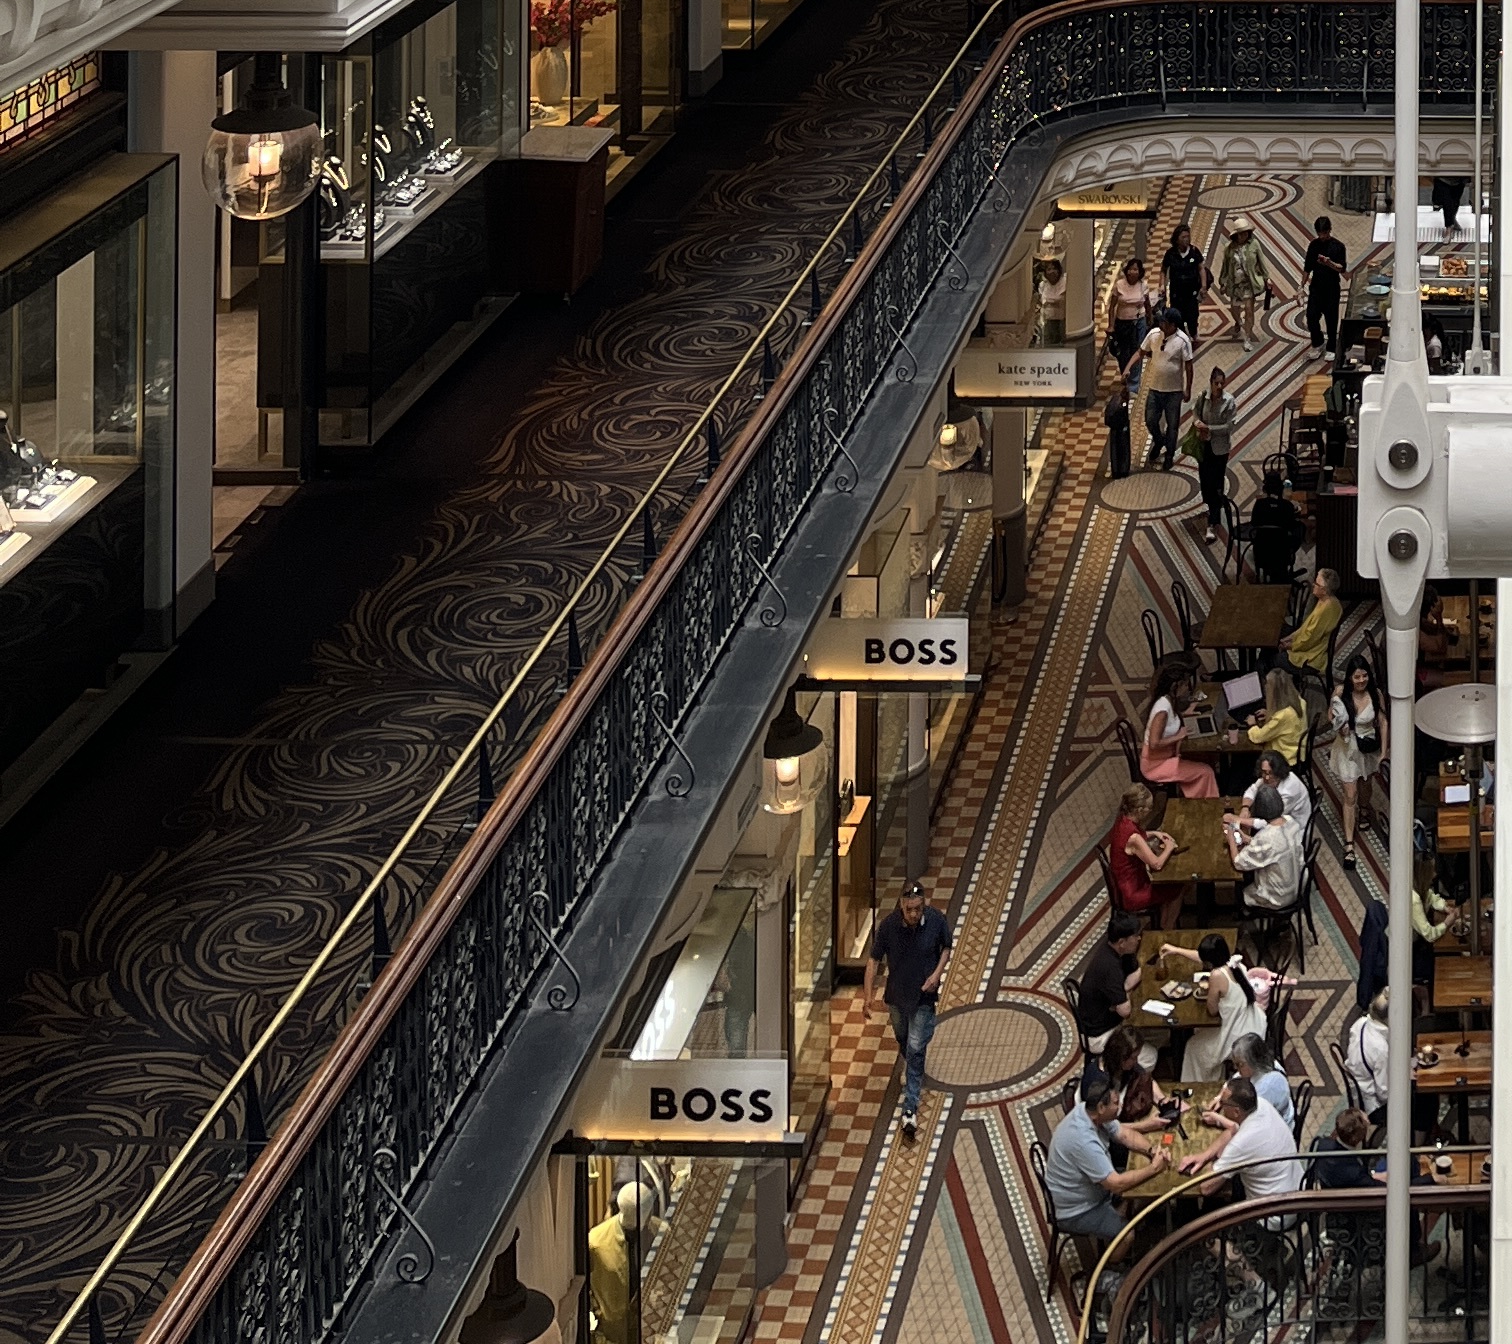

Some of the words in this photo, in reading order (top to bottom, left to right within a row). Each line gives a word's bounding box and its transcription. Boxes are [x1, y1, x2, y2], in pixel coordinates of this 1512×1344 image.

[1078, 194, 1141, 205] SWAROVSKI
[998, 363, 1026, 374] kate
[1030, 363, 1069, 378] spade
[865, 638, 957, 665] BOSS
[650, 1087, 773, 1123] BOSS
